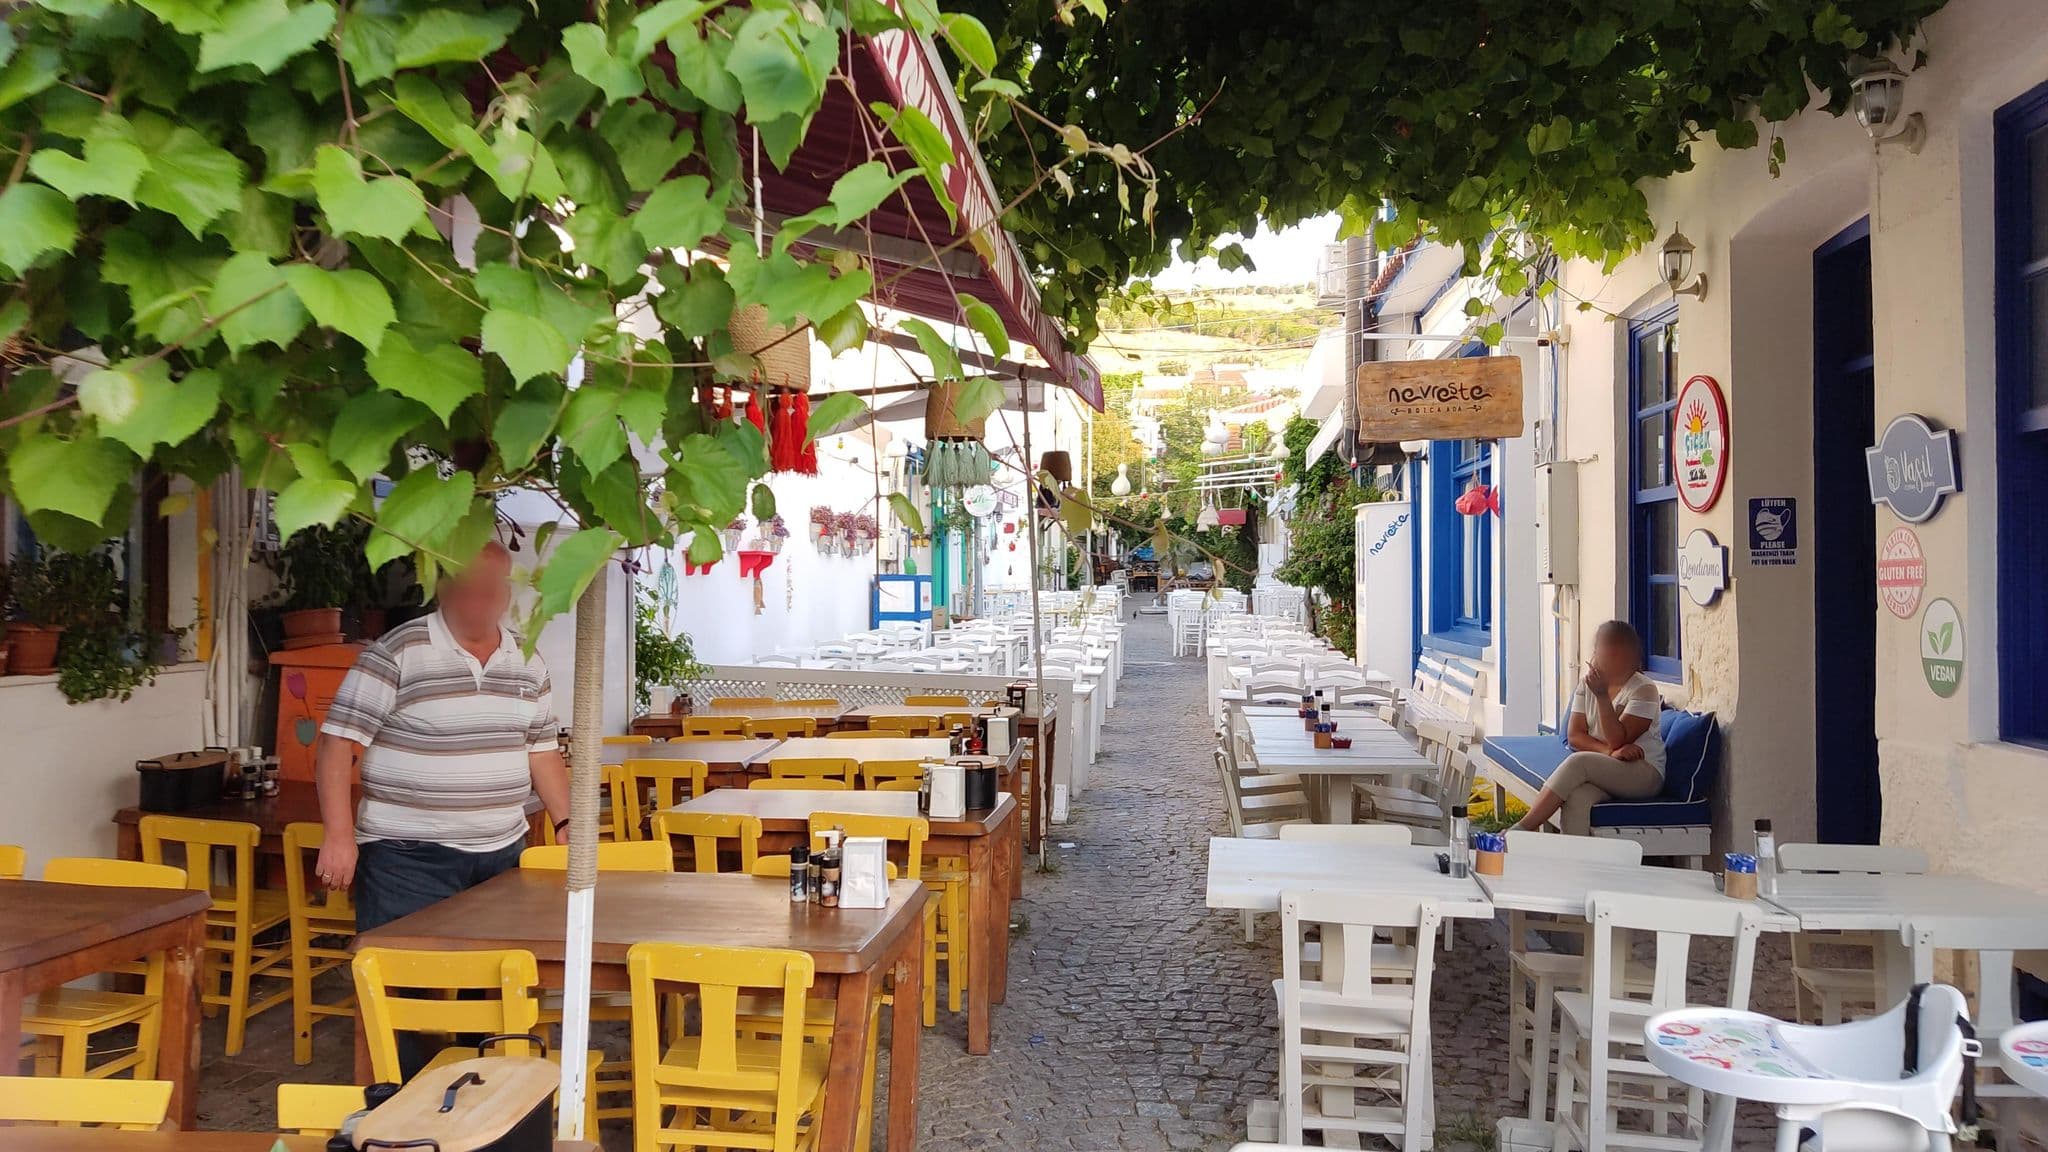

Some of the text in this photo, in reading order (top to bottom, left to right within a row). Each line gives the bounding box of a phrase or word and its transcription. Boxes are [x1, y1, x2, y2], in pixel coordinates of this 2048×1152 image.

[1388, 381, 1493, 403] nevreste
[1369, 513, 1410, 556] nevreste
[1760, 541, 1785, 549] PLEASE
[1879, 565, 1923, 580] GLUTEN FREE
[1930, 664, 1956, 682] VEGAN
